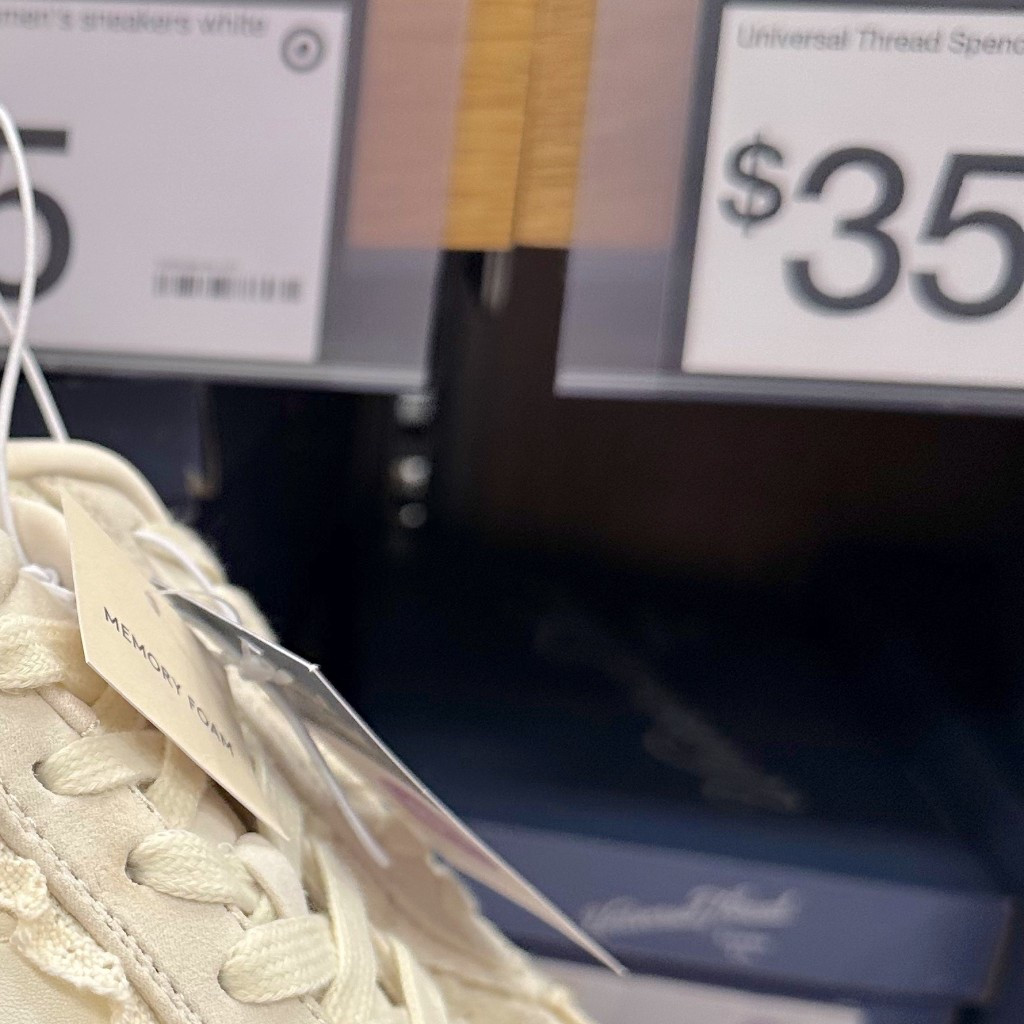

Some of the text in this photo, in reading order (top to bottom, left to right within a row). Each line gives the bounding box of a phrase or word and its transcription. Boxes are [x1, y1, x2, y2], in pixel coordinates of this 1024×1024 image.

[78, 12, 194, 35] sneakers
[198, 14, 270, 38] white
[736, 23, 847, 50] Universal
[856, 25, 940, 53] Thread
[716, 134, 1024, 322] $35
[103, 606, 235, 758] MEMORY FOAM
